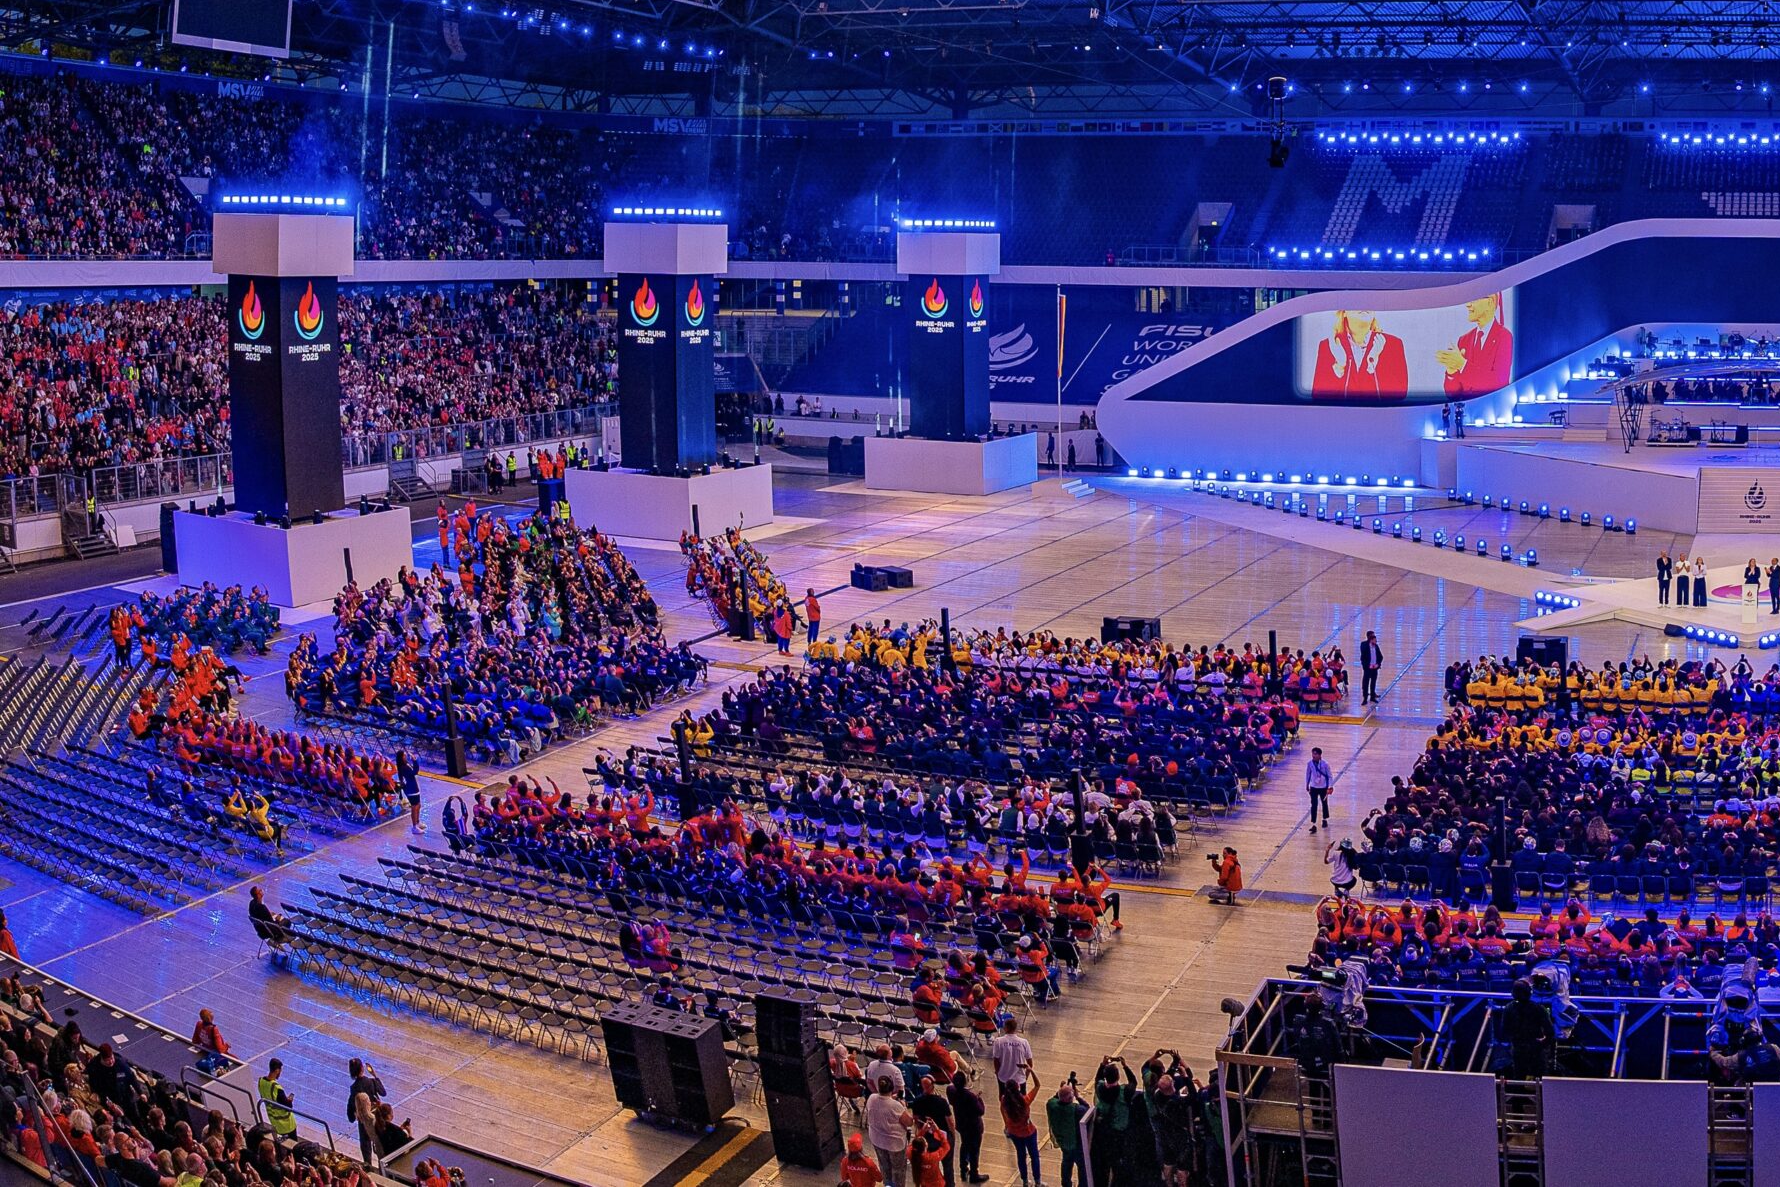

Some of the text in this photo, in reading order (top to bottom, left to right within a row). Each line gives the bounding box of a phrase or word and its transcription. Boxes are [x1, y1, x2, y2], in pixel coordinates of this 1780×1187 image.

[217, 81, 251, 99] MSV
[653, 118, 692, 133] MSV
[1320, 154, 1474, 247] M
[916, 320, 955, 328] RHINE-RUHR
[625, 329, 666, 338] RHINE-RUHR
[234, 343, 272, 354] RHINE-RUHR
[288, 343, 331, 355] RHINE-RUHR
[1134, 340, 1193, 351] WOR
[245, 352, 261, 362] 2025
[302, 352, 319, 362] 2025
